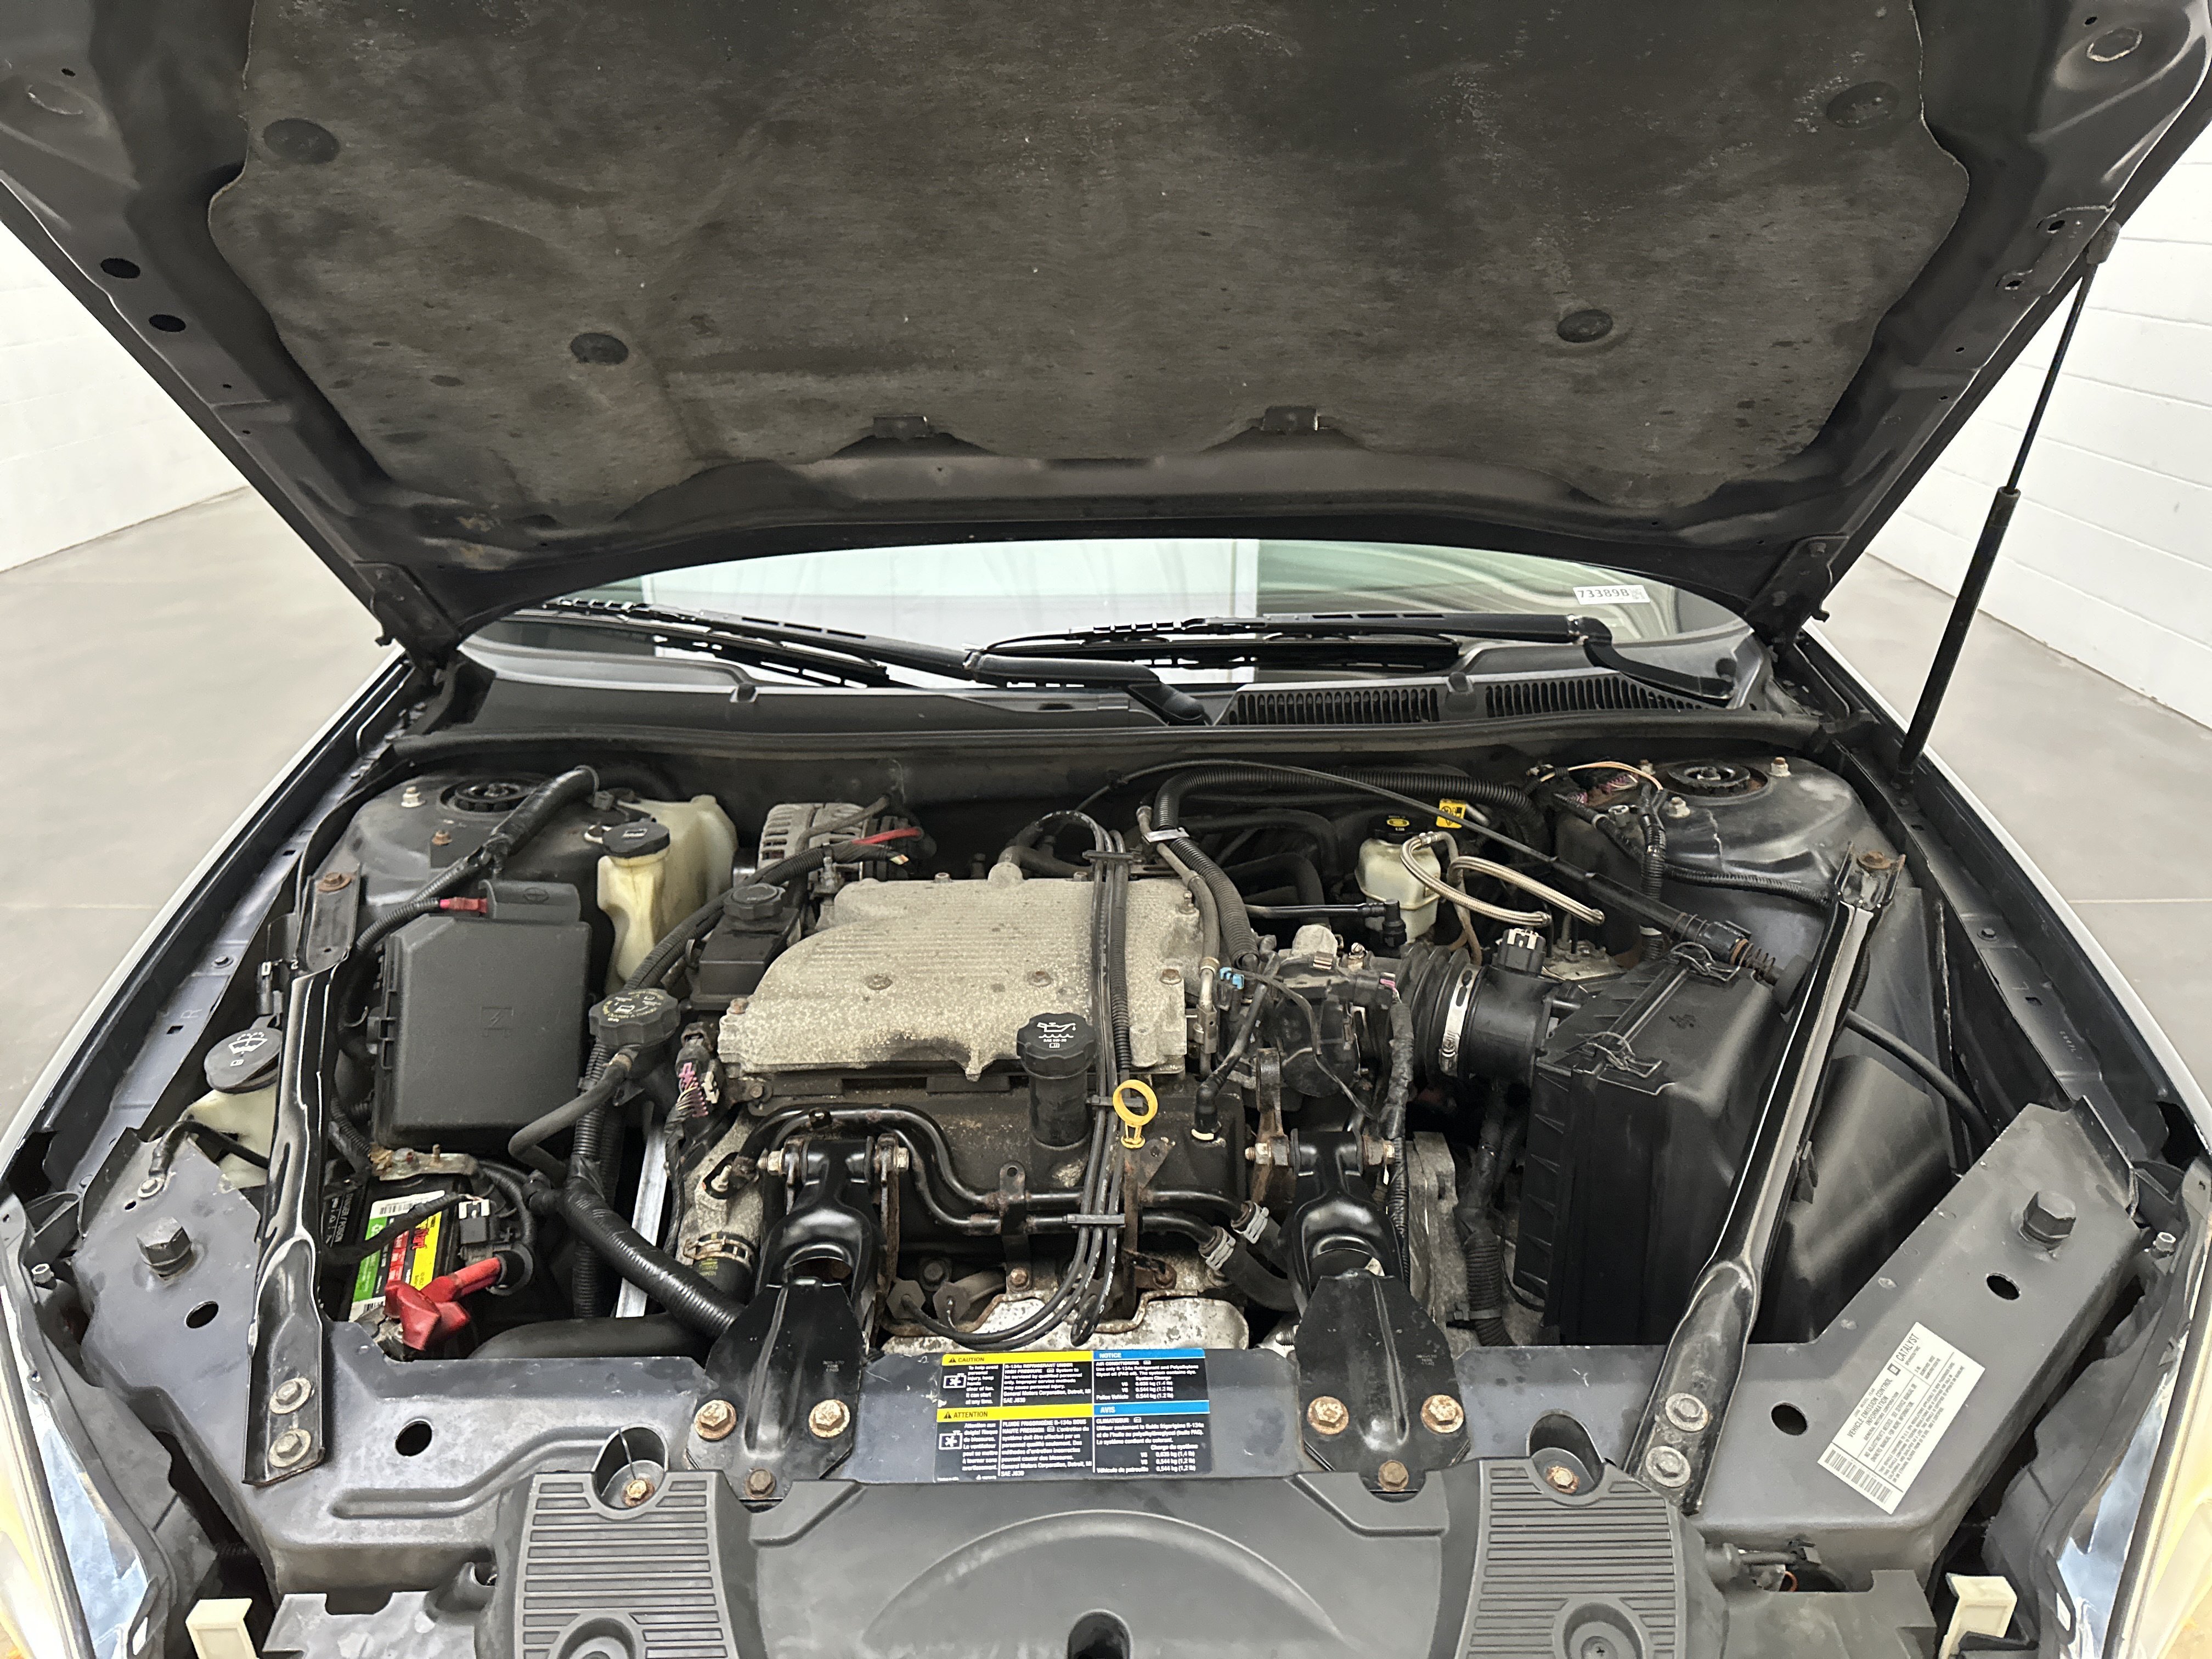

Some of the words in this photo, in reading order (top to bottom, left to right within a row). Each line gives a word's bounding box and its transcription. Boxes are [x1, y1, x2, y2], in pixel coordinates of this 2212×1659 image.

[1895, 1333, 1919, 1362] CATALYST
[1847, 1417, 1864, 1438] VEHICLE
[1860, 1396, 1878, 1419] EMISSION
[1875, 1376, 1892, 1398] CONTROL
[1863, 1425, 1876, 1441] GENERAL
[1873, 1412, 1884, 1426] MOTORS
[1882, 1391, 1899, 1413] CORPORATION
[1865, 1395, 1888, 1426] INFORMATION
